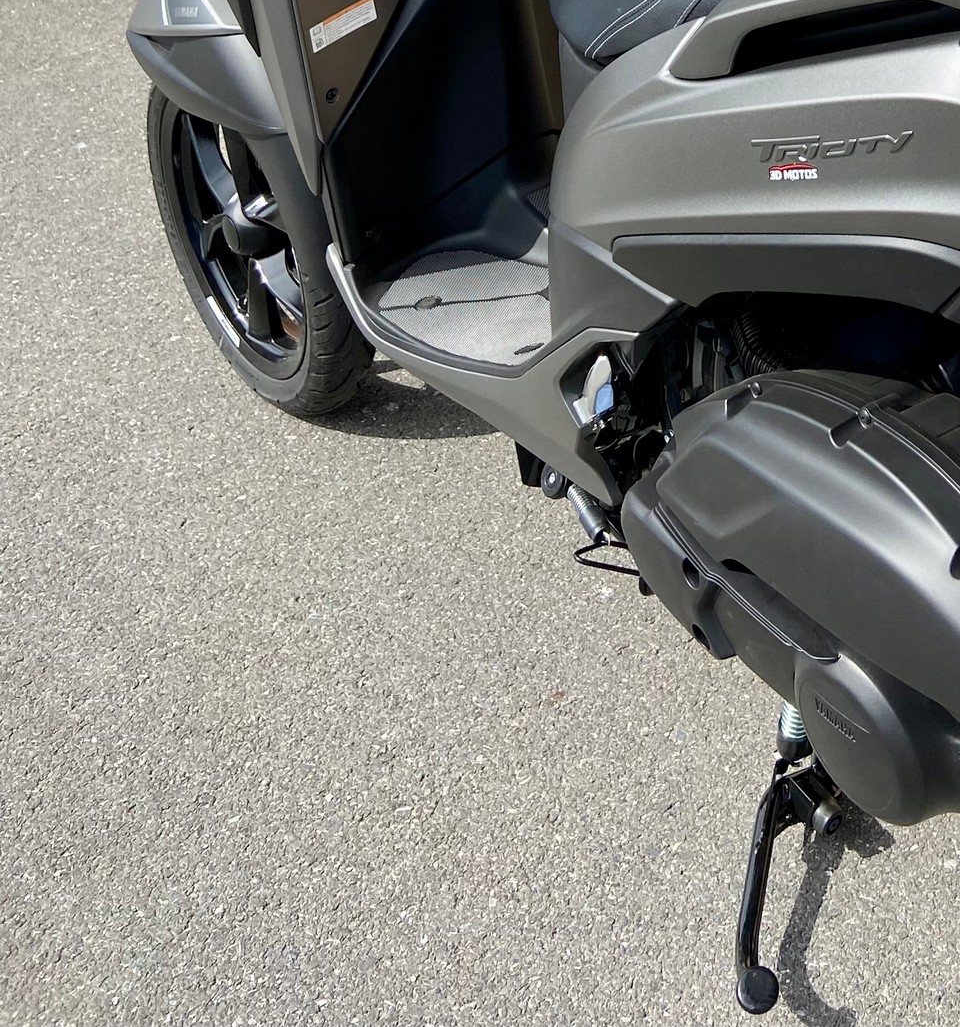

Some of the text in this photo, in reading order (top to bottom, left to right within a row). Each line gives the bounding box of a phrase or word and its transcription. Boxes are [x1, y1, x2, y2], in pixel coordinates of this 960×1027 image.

[174, 6, 199, 17] YAMAHA
[769, 169, 818, 181] 3D MOTOS
